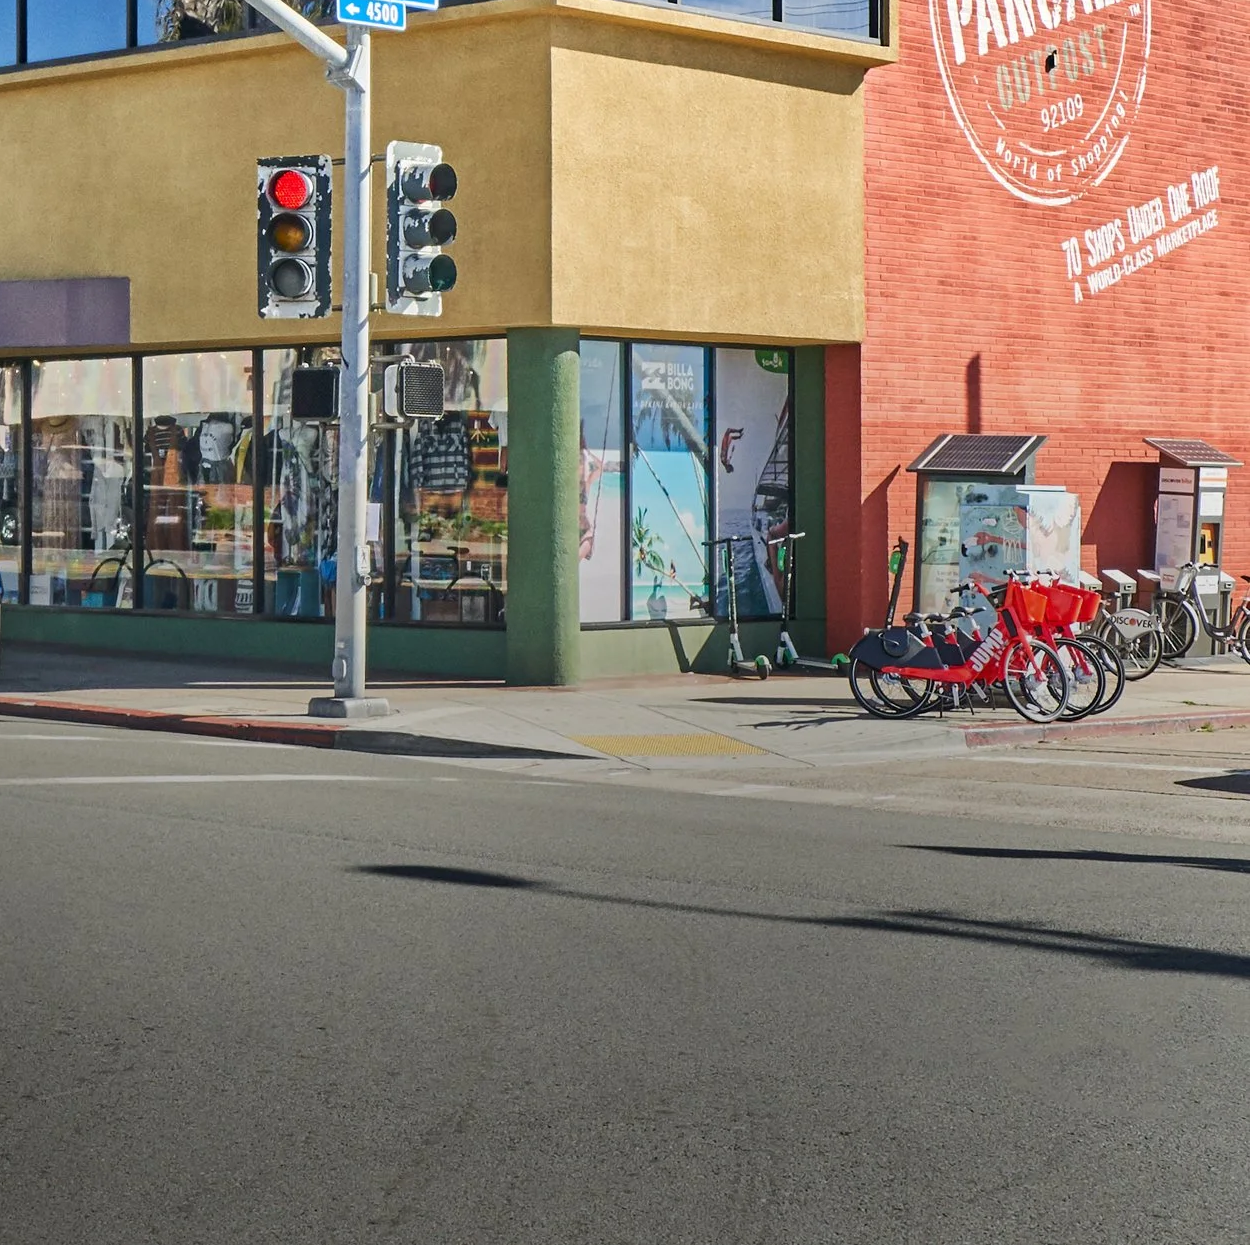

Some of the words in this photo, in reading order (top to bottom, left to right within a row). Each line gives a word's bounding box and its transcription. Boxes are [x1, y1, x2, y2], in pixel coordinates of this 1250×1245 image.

[365, 1, 399, 24] 4500
[1128, 3, 1142, 17] TM
[1041, 93, 1084, 132] 92109
[995, 137, 1038, 180] World
[1047, 163, 1062, 182] of
[1061, 236, 1083, 280] 70
[1084, 218, 1126, 268] SHOPS
[1126, 197, 1166, 244] UNDER
[1166, 182, 1192, 222] ONE
[1191, 165, 1220, 209] ROOF
[1074, 282, 1084, 304] A
[1086, 245, 1154, 295] WORLD-CLASS
[1155, 209, 1219, 257] MARKETPLACE
[667, 363, 694, 377] BILLA
[667, 377, 694, 391] BONG
[972, 627, 1003, 673] JUMP
